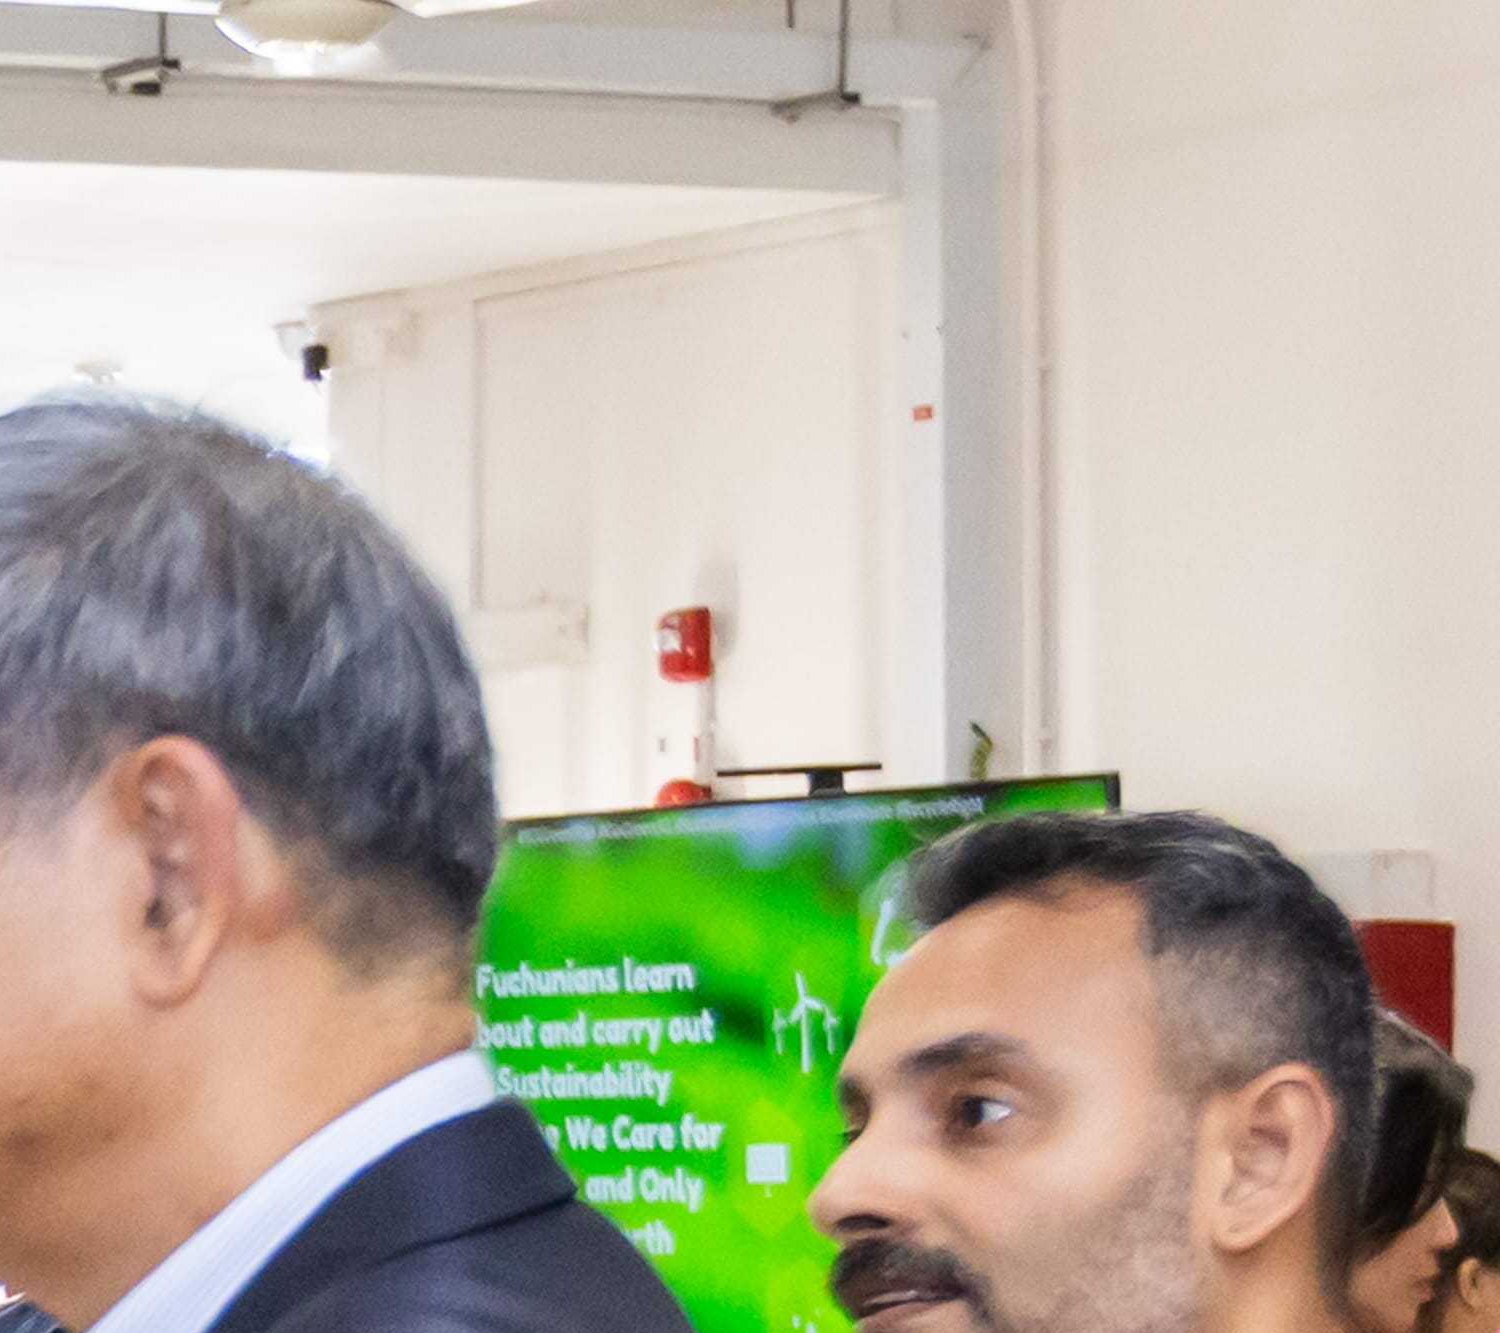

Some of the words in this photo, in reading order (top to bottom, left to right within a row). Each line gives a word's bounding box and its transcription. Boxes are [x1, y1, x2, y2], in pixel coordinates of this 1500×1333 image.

[476, 958, 619, 998] Fuchunians
[623, 956, 695, 993] learn
[477, 1013, 534, 1049] bout
[539, 1009, 586, 1048] and
[592, 1017, 662, 1055] carry
[668, 1007, 715, 1044] out
[497, 1061, 672, 1108] Sustainability
[565, 1115, 607, 1152] We
[612, 1114, 675, 1152] Care
[679, 1113, 726, 1151] for
[584, 1165, 634, 1203] and
[638, 1165, 705, 1214] Only
